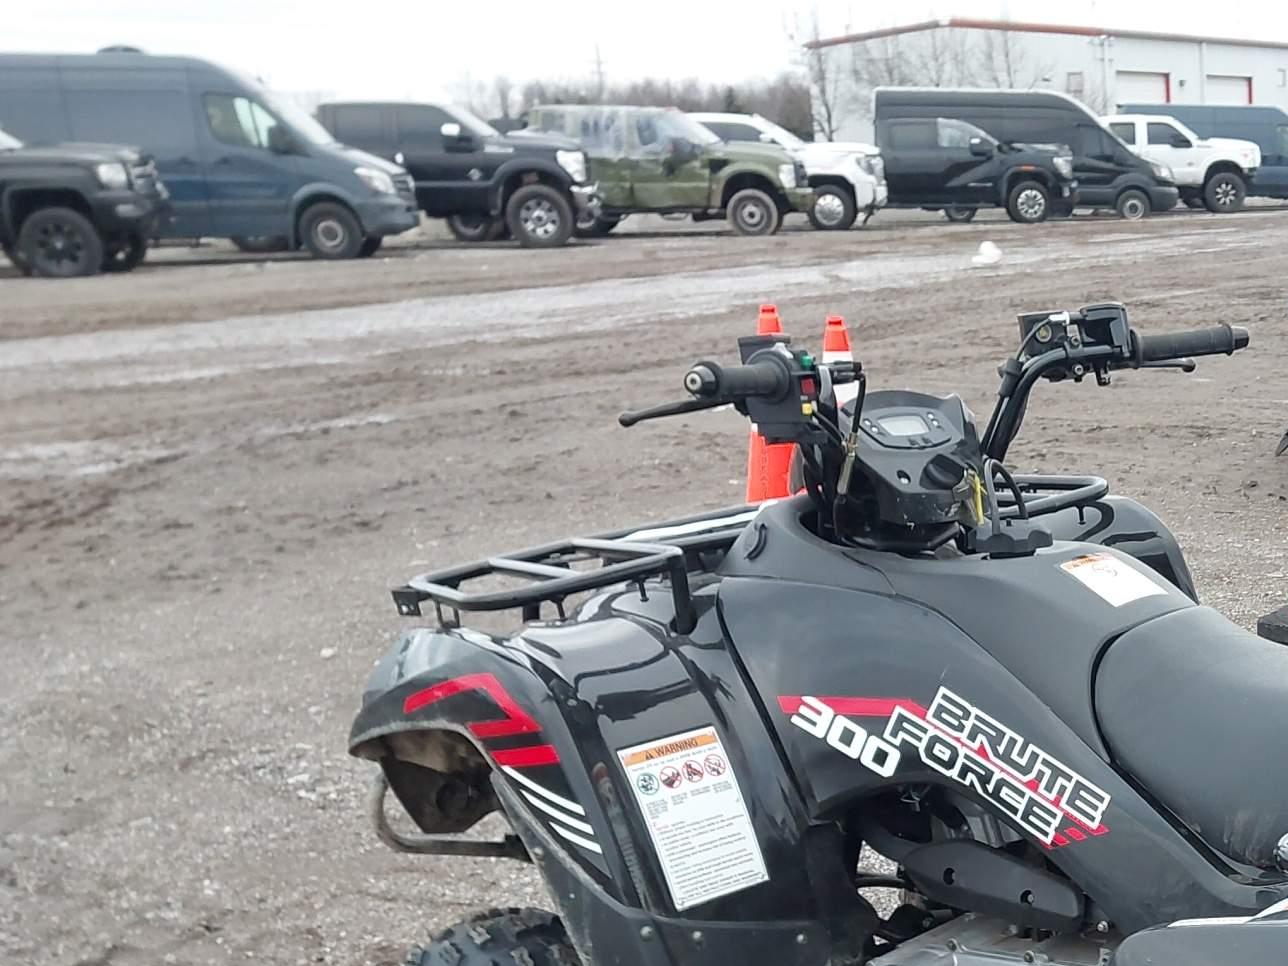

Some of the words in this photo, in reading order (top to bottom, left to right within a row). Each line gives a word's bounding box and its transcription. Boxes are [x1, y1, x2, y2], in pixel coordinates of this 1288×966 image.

[655, 738, 698, 757] WARNING
[790, 695, 901, 777] 300
[883, 705, 1064, 844] FORCE
[926, 686, 1111, 829] BRUTE
